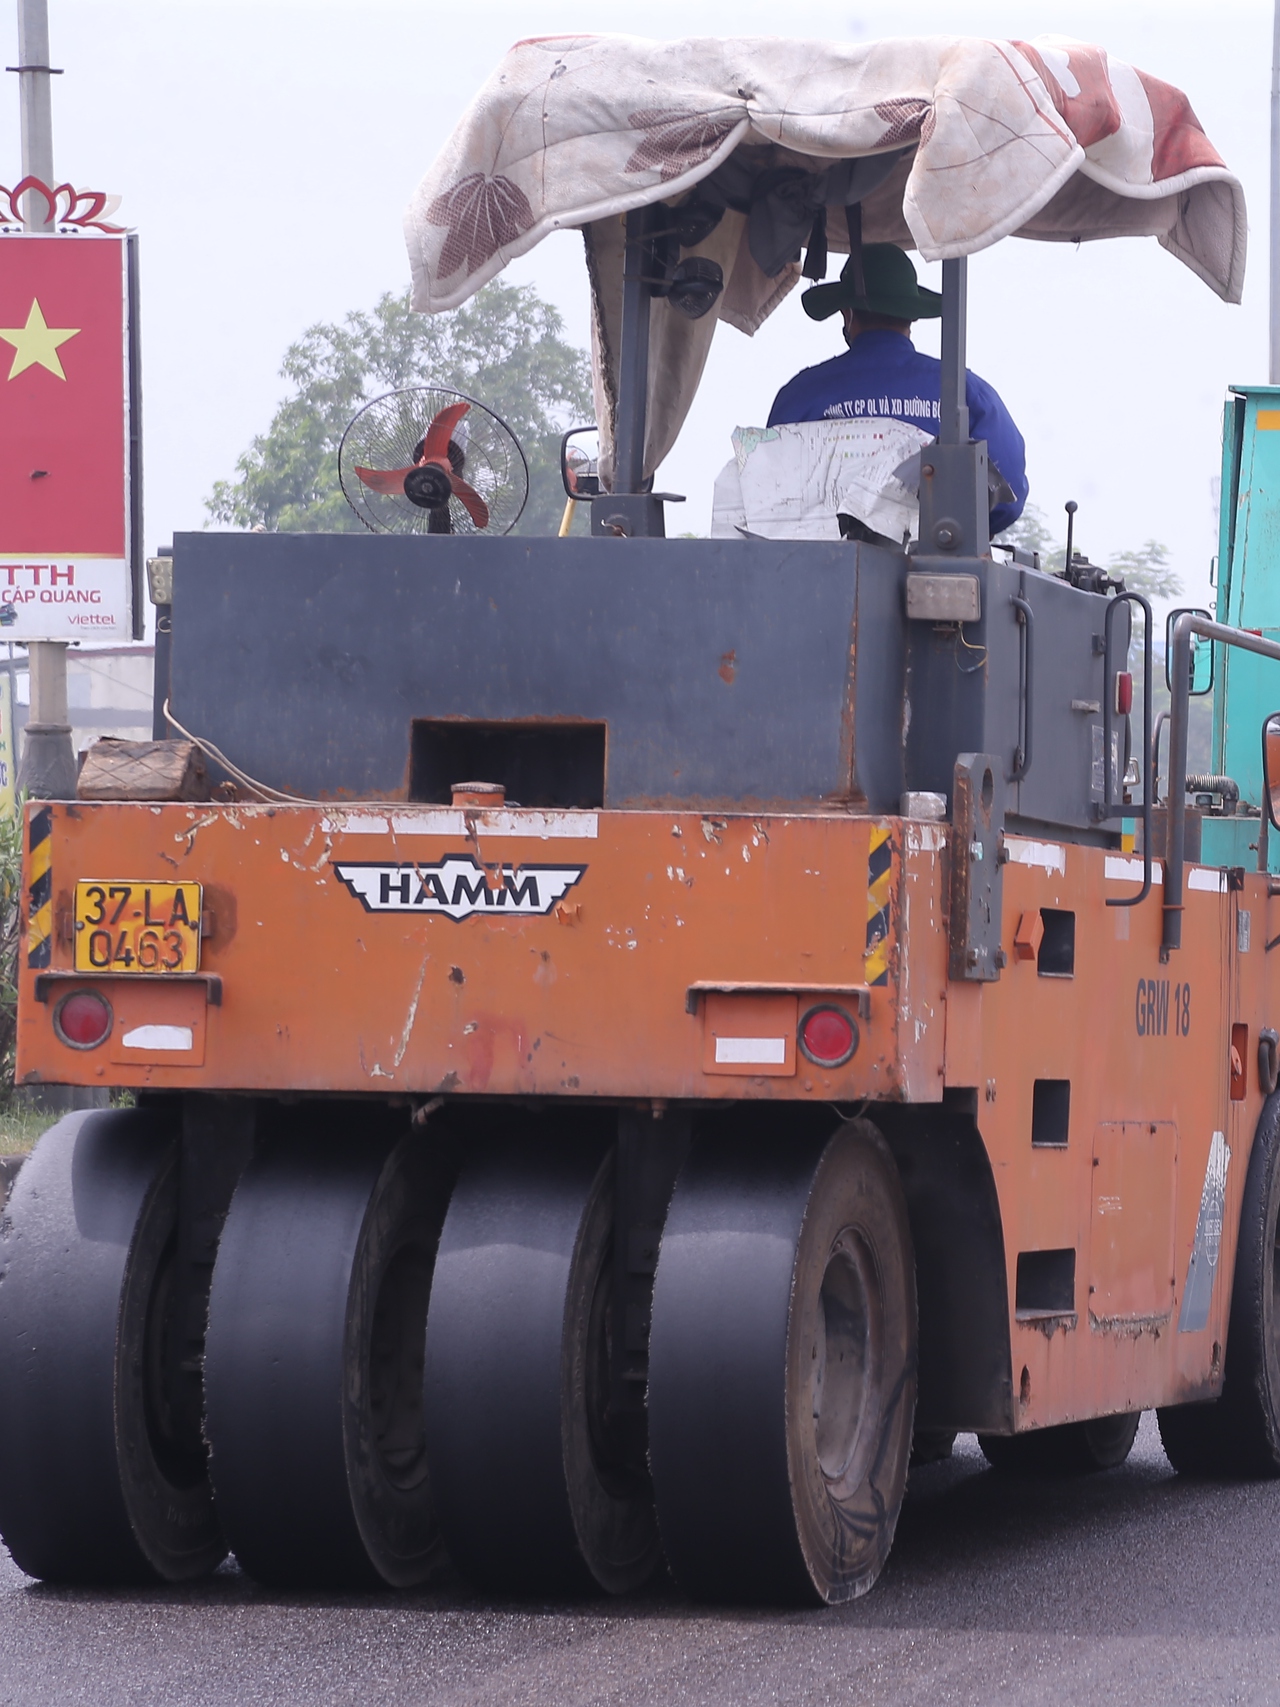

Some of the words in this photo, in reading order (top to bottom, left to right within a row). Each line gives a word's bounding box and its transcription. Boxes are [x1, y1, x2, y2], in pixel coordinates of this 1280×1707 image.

[844, 400, 855, 417] TY
[855, 399, 865, 415] CP
[867, 399, 877, 416] QL
[879, 395, 890, 415] VÀ
[891, 398, 901, 416] XD
[40, 590, 102, 604] QUANG
[68, 614, 117, 625] viettel
[85, 886, 190, 926] 37-LA
[379, 872, 541, 907] HAMM
[89, 930, 184, 968] 0463
[1136, 978, 1170, 1037] GRW
[1174, 982, 1191, 1037] 18
